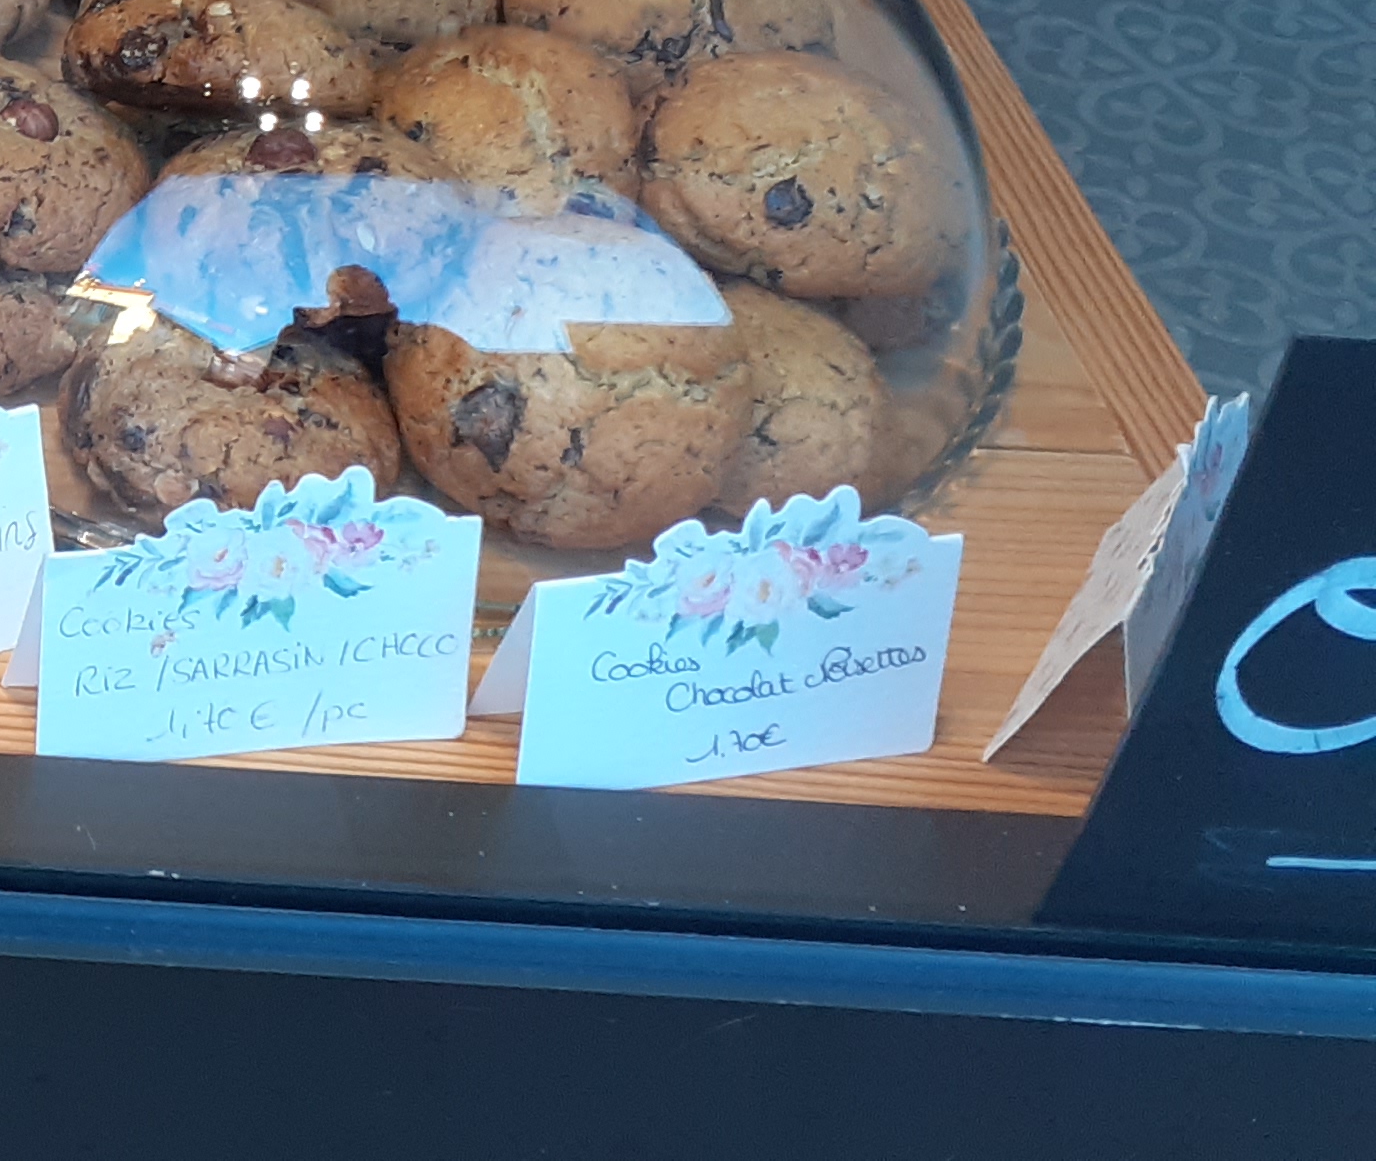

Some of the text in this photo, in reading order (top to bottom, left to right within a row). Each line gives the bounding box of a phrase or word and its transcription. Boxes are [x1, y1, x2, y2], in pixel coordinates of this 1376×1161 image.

[59, 606, 201, 638] Cookies
[591, 642, 701, 682] Cookies
[666, 673, 798, 713] Chocolat
